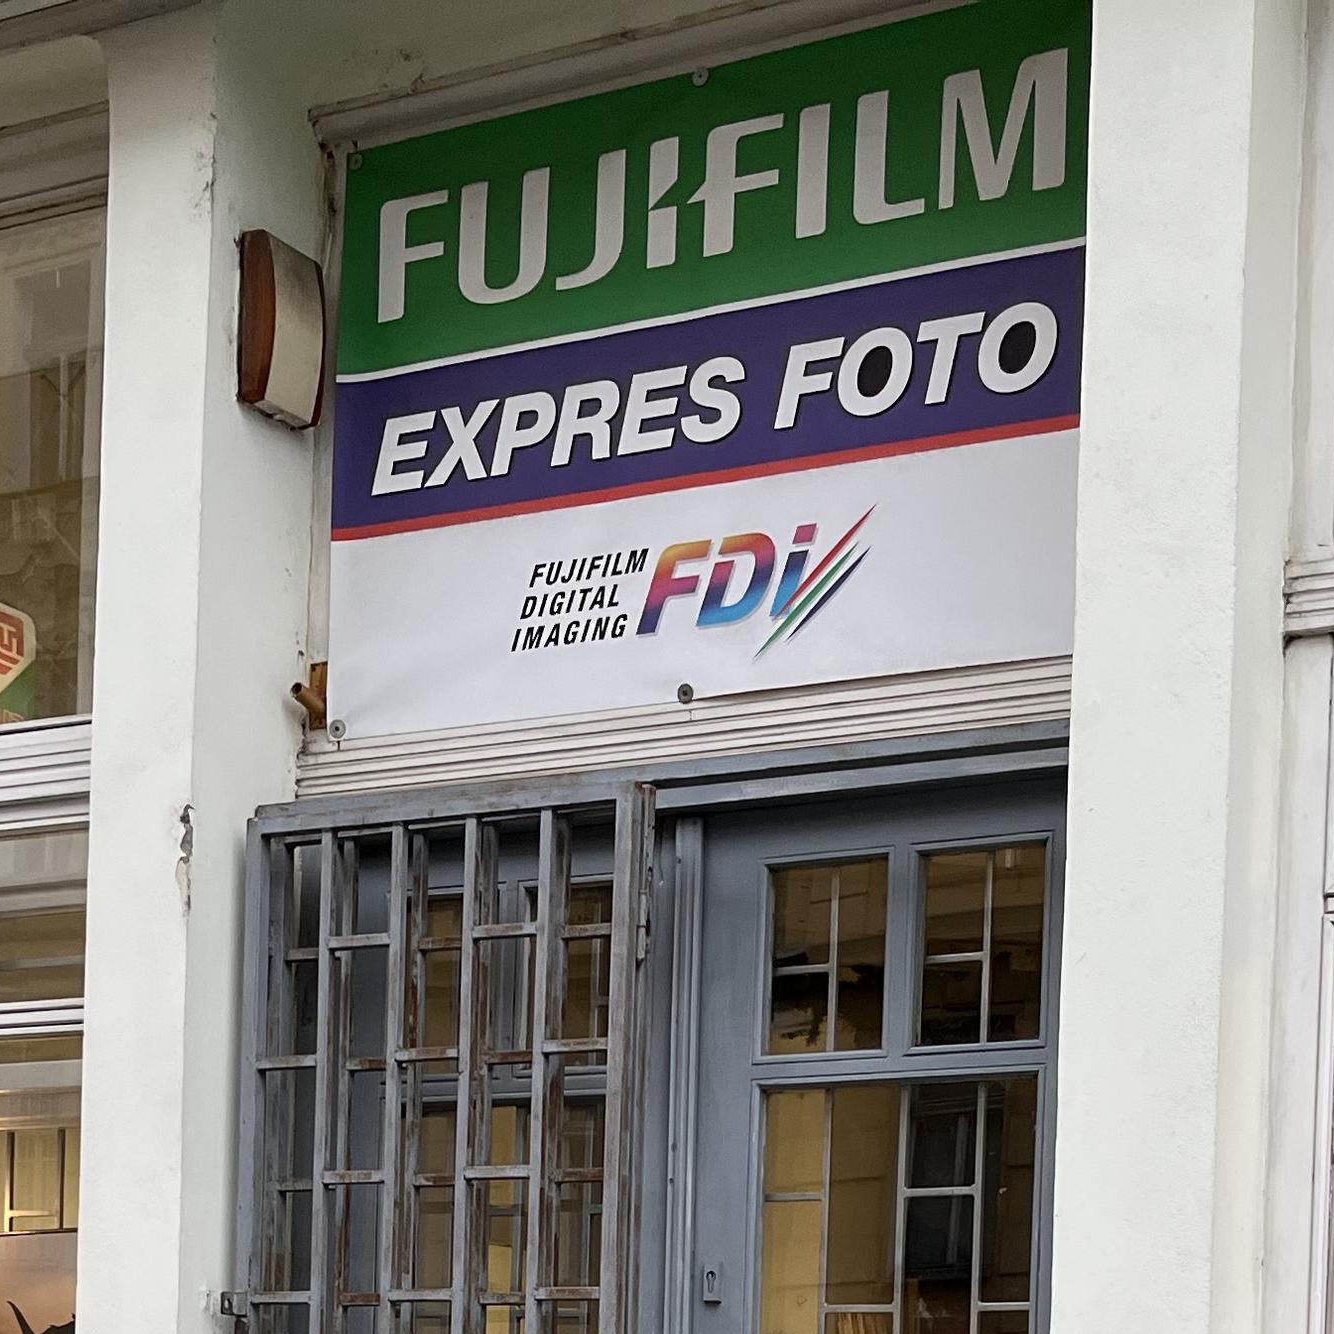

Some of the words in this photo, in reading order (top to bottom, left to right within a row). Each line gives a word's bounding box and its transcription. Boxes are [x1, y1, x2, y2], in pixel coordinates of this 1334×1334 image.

[376, 48, 1069, 323] FUJIFILM
[372, 356, 746, 496] EXPRES
[774, 302, 1058, 430] FOTO
[520, 584, 620, 620] DIGITAL
[529, 548, 649, 588] FUJIFILM
[636, 523, 818, 636] FDi
[511, 614, 628, 652] IMAGING
